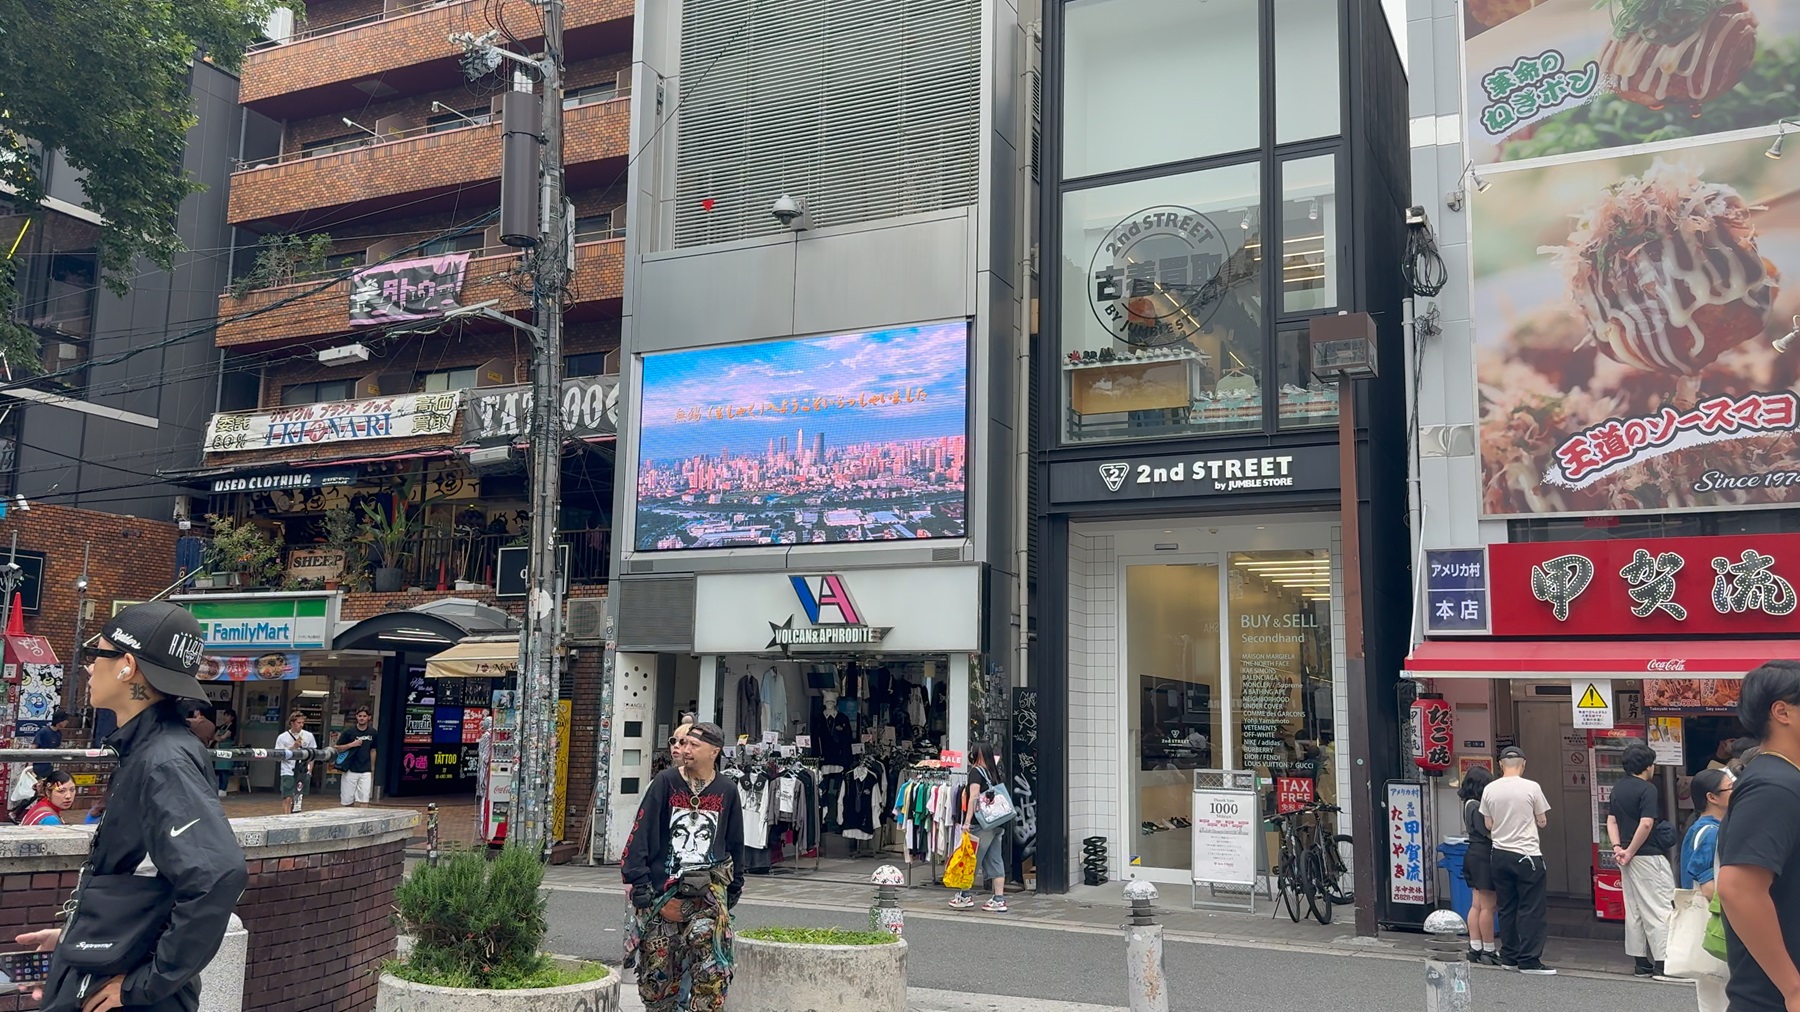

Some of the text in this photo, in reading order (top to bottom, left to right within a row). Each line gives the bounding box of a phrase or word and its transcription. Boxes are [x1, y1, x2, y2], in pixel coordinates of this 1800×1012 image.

[1485, 64, 1595, 130] ねぎポン
[1105, 212, 1214, 257] 2nd STREET
[1104, 303, 1123, 322] BY
[1558, 396, 1795, 477] 王道のソースマヨ
[1136, 455, 1293, 483] 2nd STREET
[215, 479, 247, 492] USED
[249, 473, 311, 489] CLOTHING
[1214, 477, 1293, 491] by JUMBLE STORE
[1694, 470, 1800, 491] Since 197
[293, 555, 343, 568] SHEEP
[1431, 562, 1481, 578] アメリカ村
[1531, 548, 1798, 622] 甲賀流
[1435, 600, 1479, 620] 本店
[1241, 613, 1318, 628] BUY & SELL
[213, 622, 290, 642] FamilyMart
[775, 627, 874, 644] VOLCAN&APHRODITE
[1242, 633, 1305, 643] Secondhand
[1647, 659, 1686, 671] Coca-Cola
[1277, 682, 1303, 690] Supreme
[1427, 704, 1451, 765] たこ焼
[434, 753, 457, 765] TATTOO
[941, 755, 962, 764] SALE
[1280, 779, 1310, 793] TAX
[1390, 787, 1419, 799] アメリカ村
[1281, 792, 1310, 803] FREE
[1209, 802, 1238, 816] 1000
[1390, 805, 1405, 879] たこやき
[1403, 820, 1423, 883] 甲賀流
[1394, 885, 1424, 895] 年中無休
